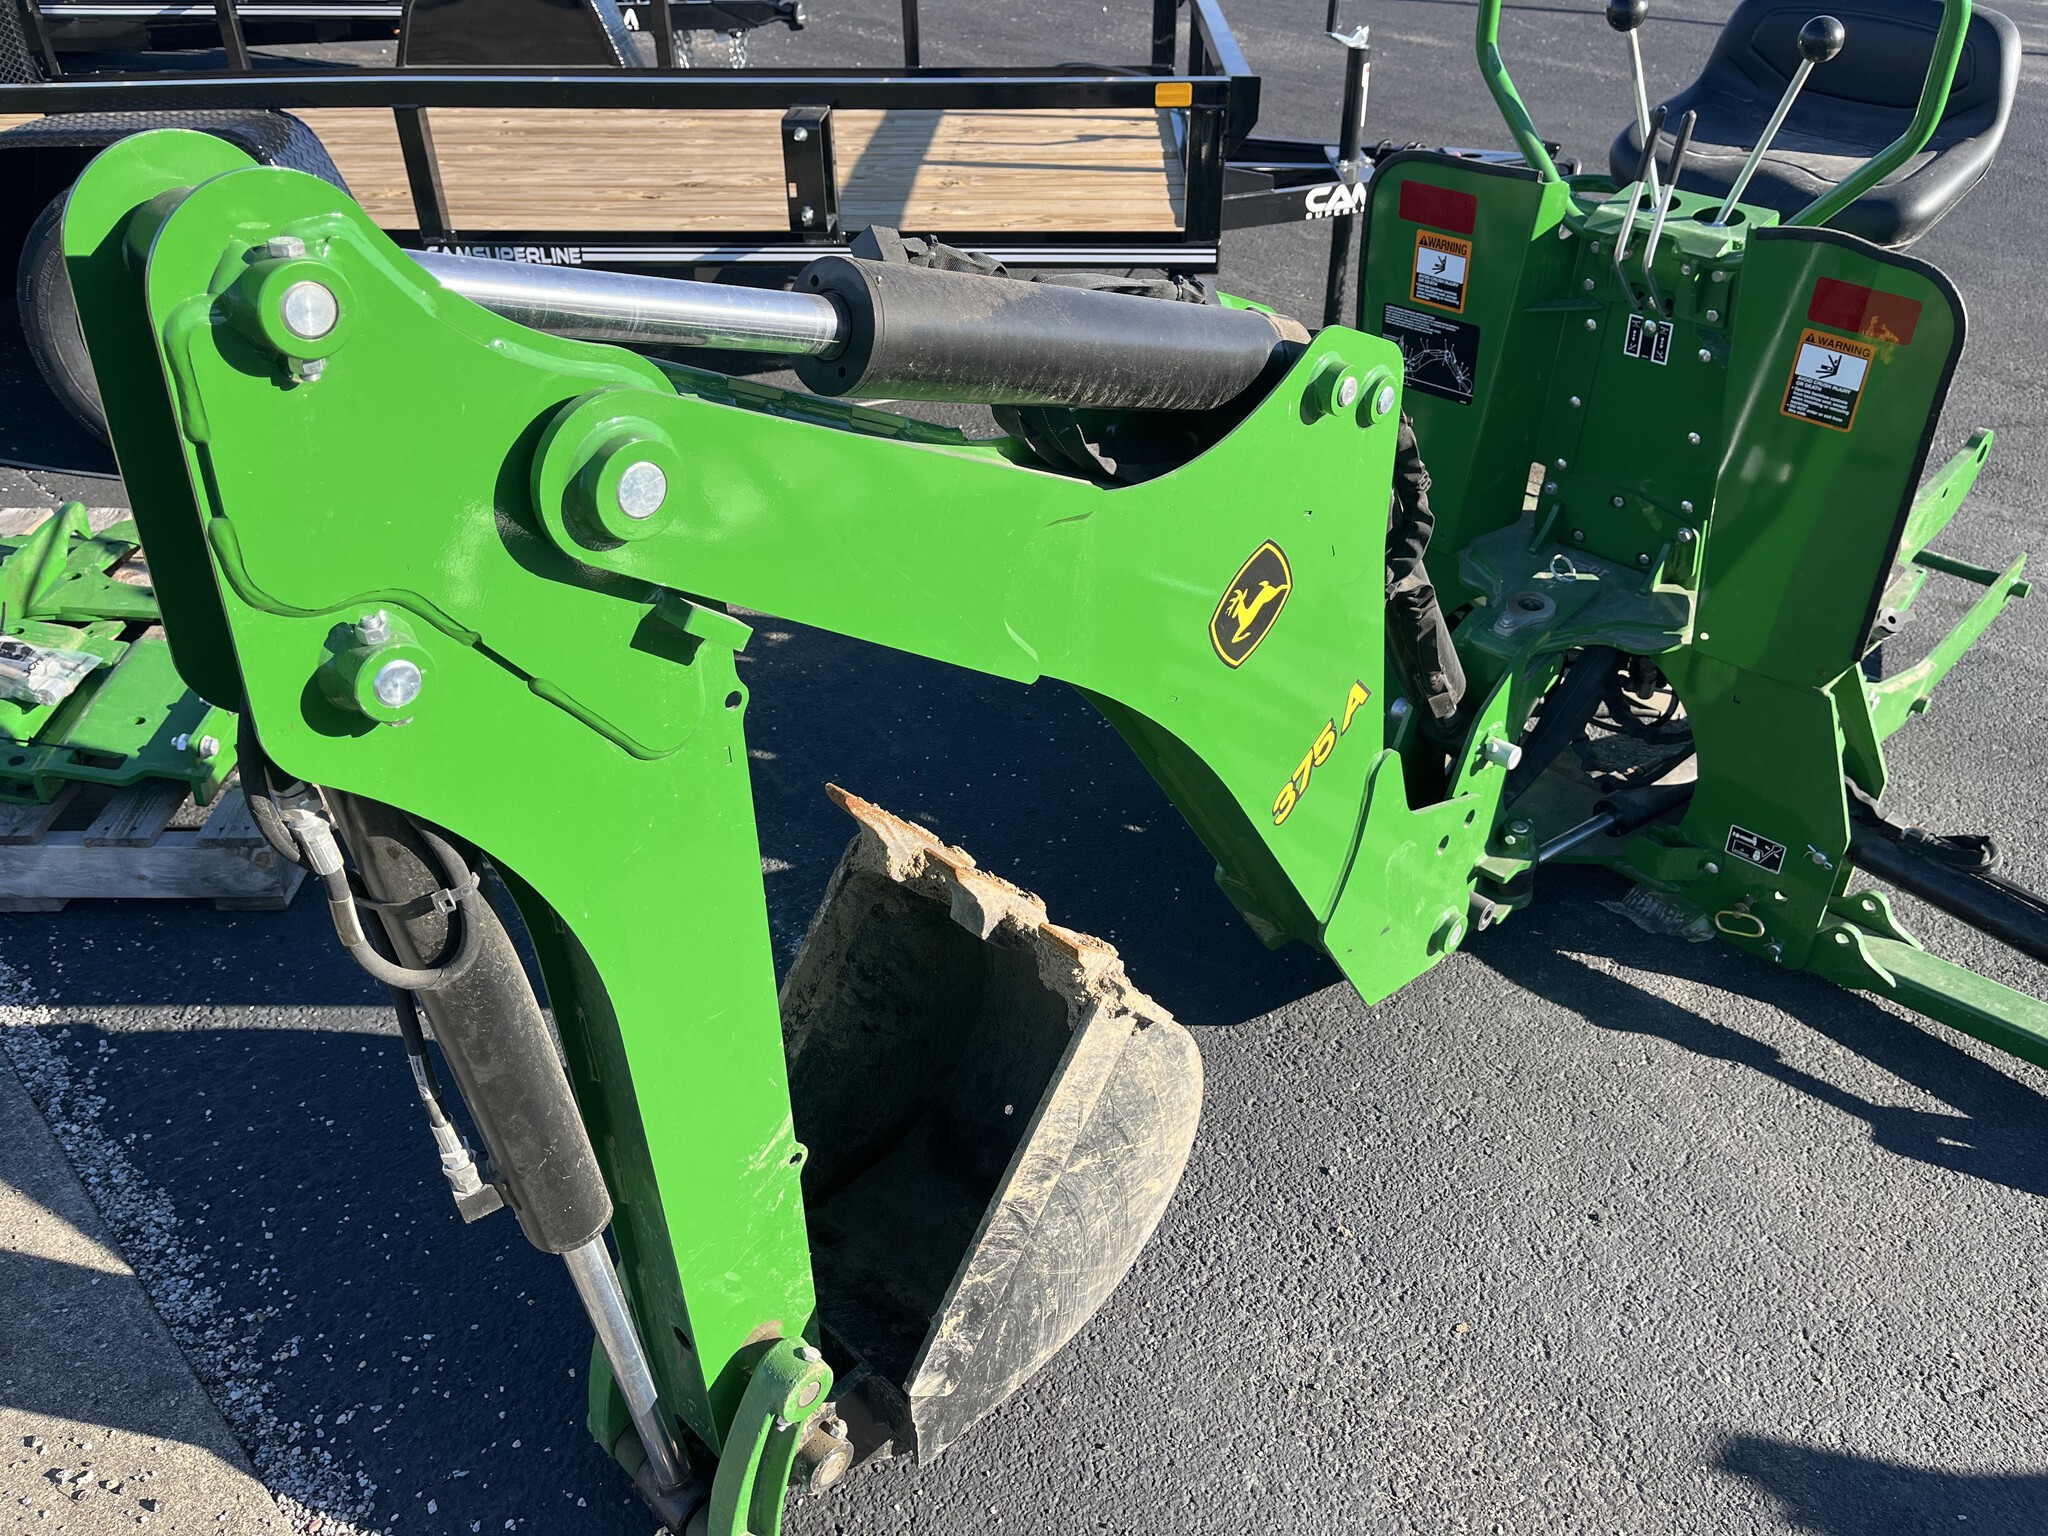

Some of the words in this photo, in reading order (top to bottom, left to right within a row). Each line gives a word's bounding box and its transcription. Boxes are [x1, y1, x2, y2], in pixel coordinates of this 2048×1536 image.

[1428, 236, 1468, 256] WARNING
[1818, 336, 1871, 358] WARNING
[1272, 717, 1337, 826] 375
[1340, 678, 1372, 737] A
